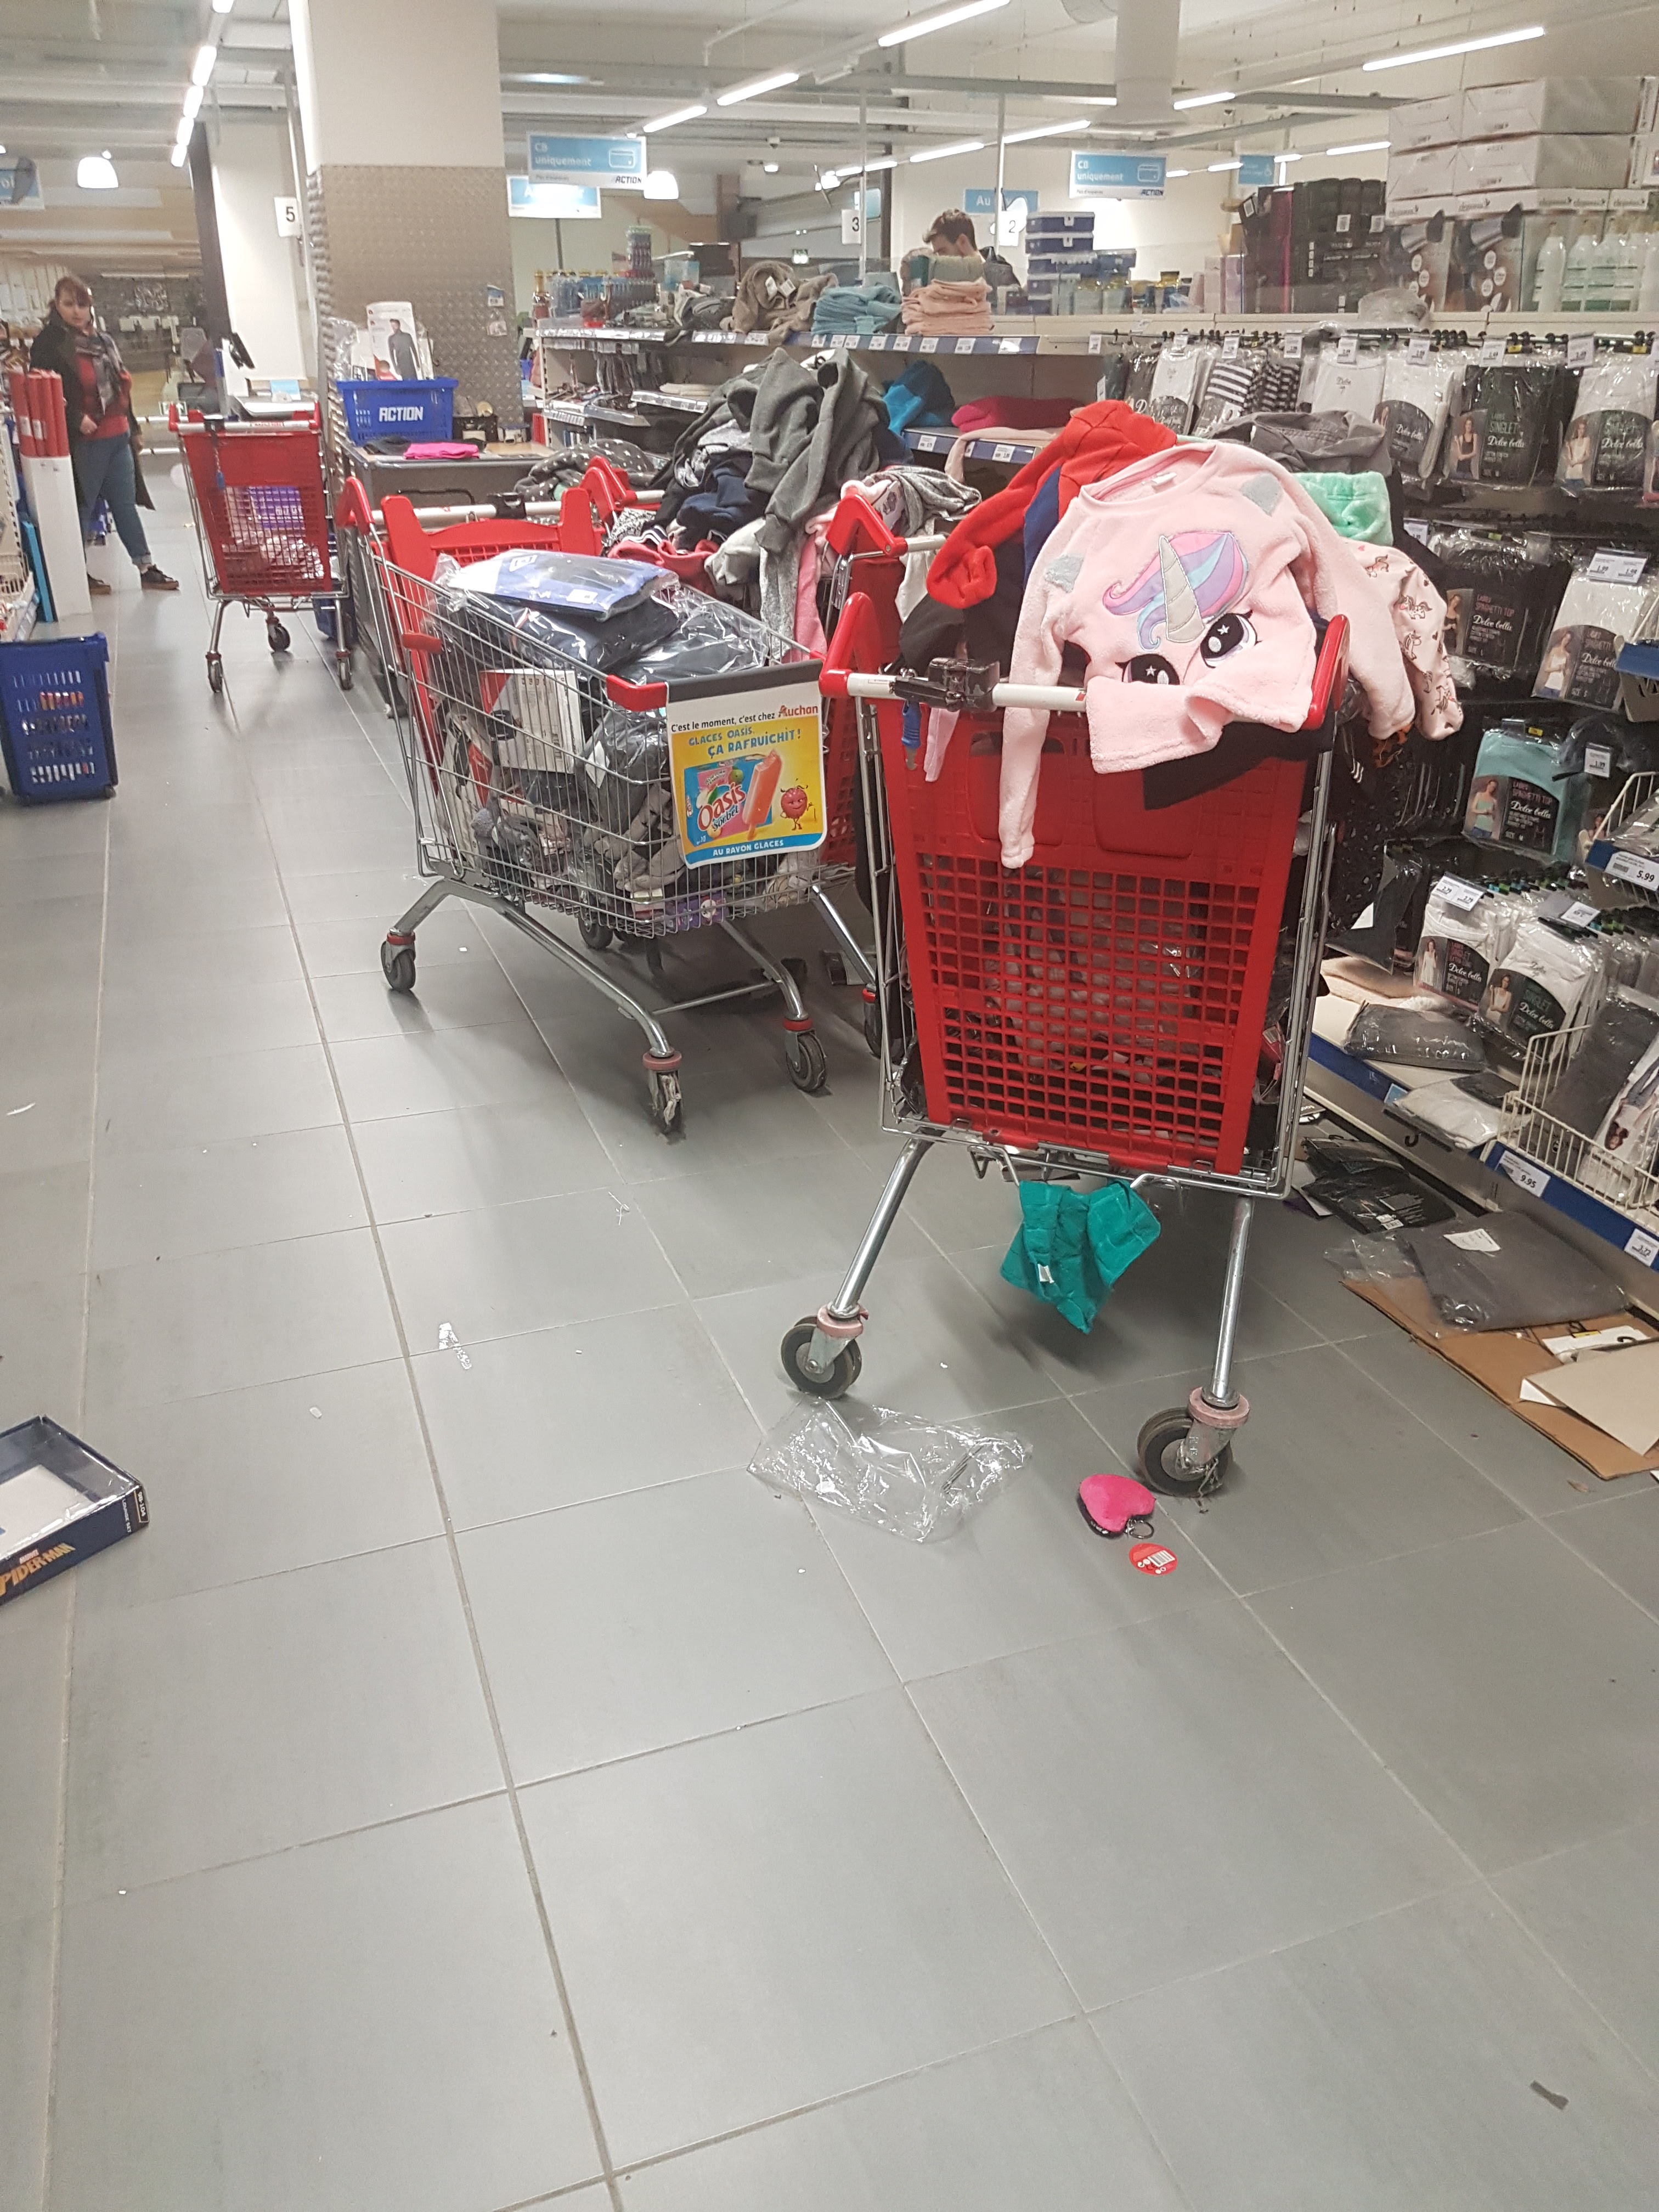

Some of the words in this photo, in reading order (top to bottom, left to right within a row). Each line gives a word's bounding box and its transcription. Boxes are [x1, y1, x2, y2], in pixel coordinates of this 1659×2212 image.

[535, 155, 591, 167] uniquement
[615, 175, 642, 184] ACTION
[1077, 173, 1124, 182] uniquement
[976, 195, 991, 206] Au
[286, 206, 296, 223] 5
[851, 216, 860, 232] 3
[1008, 220, 1017, 234] 2
[379, 406, 424, 422] ACTION
[1487, 435, 1508, 447] Dolce
[1472, 614, 1494, 628] Dolce
[1495, 620, 1513, 631] bella
[1582, 652, 1602, 666] Dolce
[671, 721, 690, 732] C'est
[692, 721, 699, 730] le
[701, 718, 737, 729] moment,
[738, 714, 756, 724] c'est
[758, 713, 776, 721] chez
[778, 704, 819, 718] Auchan
[688, 732, 722, 747] GLACES
[707, 744, 724, 759] ÇA
[698, 782, 747, 831] Oasis
[1510, 800, 1533, 815] Dolce
[1533, 807, 1551, 819] bella
[713, 849, 724, 857] AU
[725, 844, 752, 855] RAYON
[754, 839, 784, 850] GLACES
[1637, 870, 1655, 883] 5.99
[1448, 962, 1467, 976] Dolce
[1468, 970, 1482, 983] bella
[1519, 1001, 1538, 1019] Dolce
[1538, 1014, 1554, 1029] bella
[1520, 1174, 1537, 1189] 9.95
[137, 1491, 146, 1517] 98-104
[0, 1543, 76, 1597] PIDER-MAN
